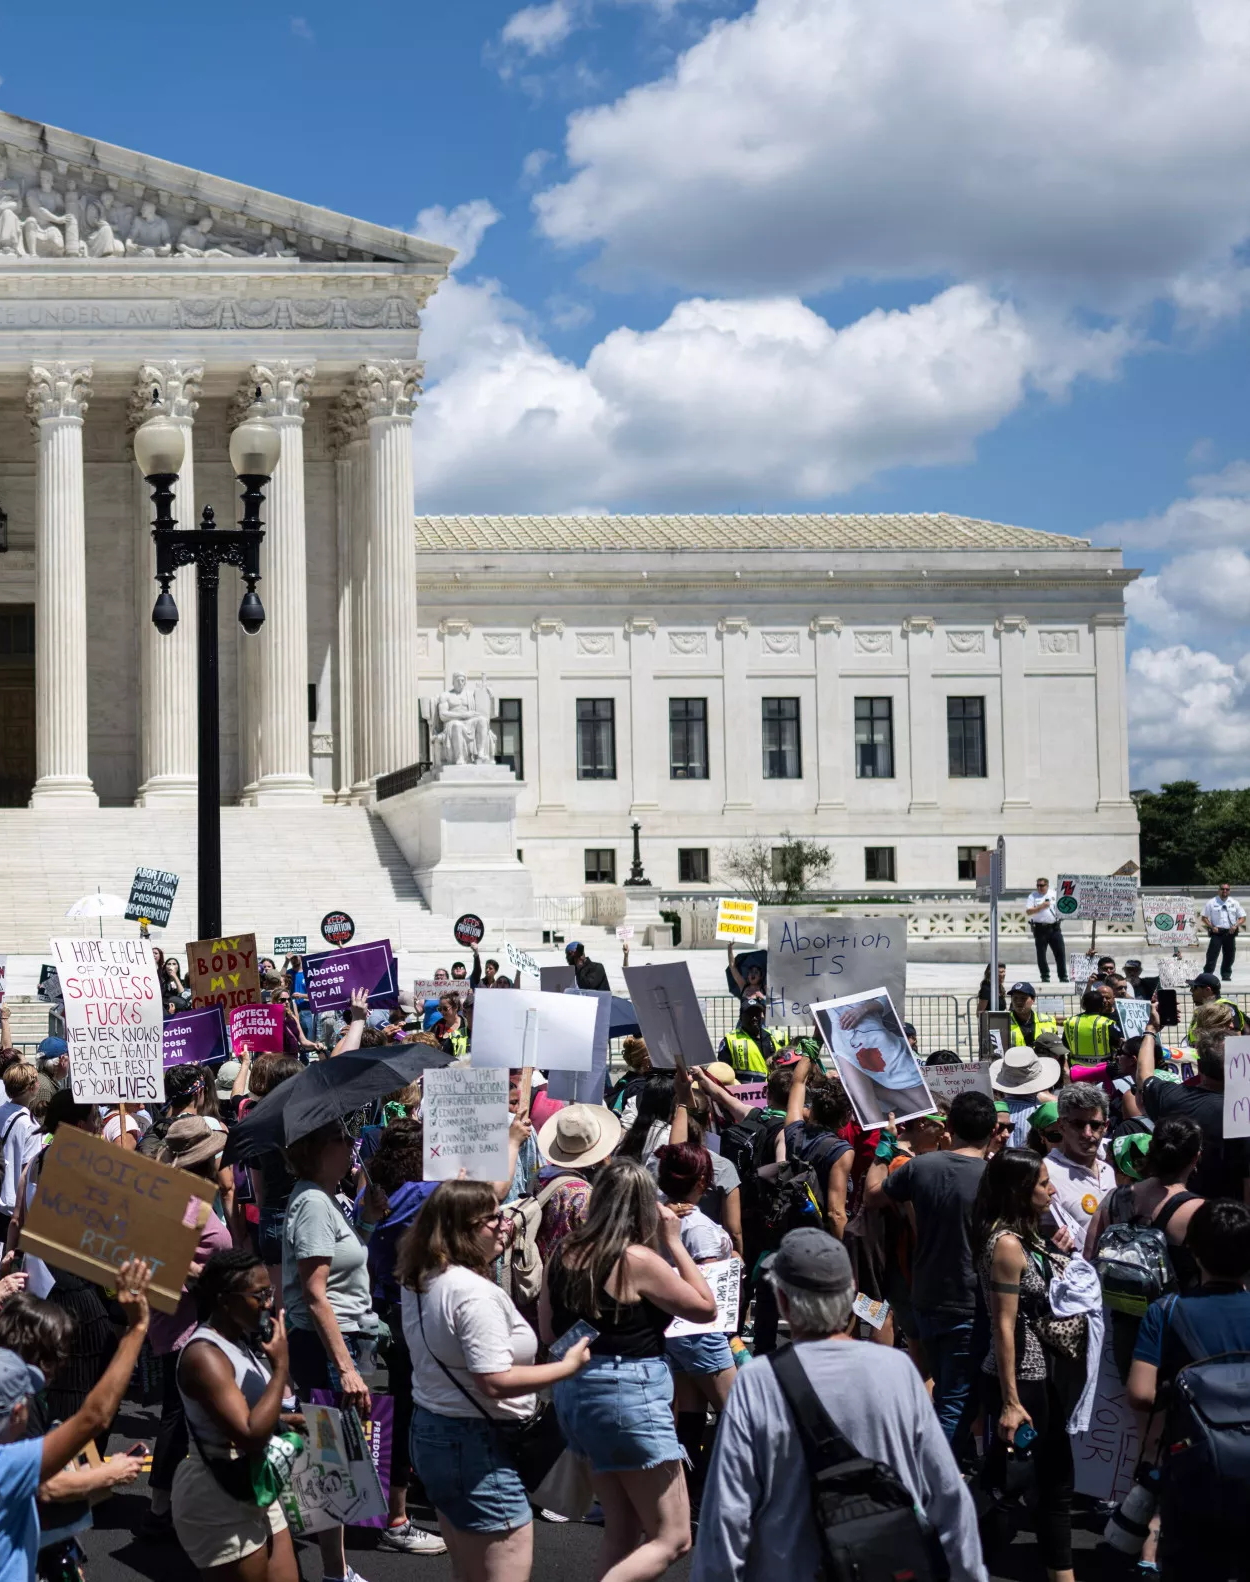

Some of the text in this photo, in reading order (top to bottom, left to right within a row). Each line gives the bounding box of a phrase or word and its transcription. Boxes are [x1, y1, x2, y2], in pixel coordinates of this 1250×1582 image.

[29, 308, 100, 324] UNDER
[113, 308, 157, 324] LAW
[136, 868, 179, 885] ABORTION
[324, 922, 351, 934] ABORTION
[457, 923, 481, 937] ABORTION
[720, 923, 754, 935] PEOPLE
[779, 921, 891, 954] Abortion
[55, 941, 147, 965] I HOPE EACH
[212, 938, 240, 954] MY
[197, 950, 254, 975] BODY
[805, 955, 845, 977] IS
[77, 965, 130, 976] OF YOU
[307, 963, 349, 978] Abortion
[66, 977, 153, 1000] SOULLESS
[211, 973, 240, 991] MY
[309, 975, 345, 988] Access
[311, 986, 341, 999] For All
[416, 990, 436, 998] WITH
[85, 1002, 142, 1026] FUCKS
[233, 1009, 269, 1020] PROTECT
[1130, 1010, 1144, 1019] FUCK
[164, 1026, 192, 1037] ortion
[232, 1018, 277, 1033] SAFE, LEGAL
[67, 1026, 160, 1043] NEVER KNOWS
[233, 1027, 273, 1041] ABORTION
[74, 1045, 116, 1061] PEACE
[120, 1044, 157, 1058] AGAIN
[171, 1049, 183, 1058] All
[73, 1060, 154, 1076] FOR THE REST
[472, 1069, 499, 1081] THAT
[936, 1065, 958, 1075] FAMILY
[73, 1076, 157, 1100] OF YOUR LIVES
[943, 1077, 960, 1085] force
[439, 1107, 475, 1117] EDUCATION
[438, 1117, 478, 1128] COMMUNITY
[442, 1134, 465, 1143] LIVING
[442, 1144, 499, 1156] ABORTION BANS
[56, 1141, 170, 1201] CHOICE
[83, 1185, 129, 1216] IS A
[41, 1187, 129, 1239] WOMEN'S
[717, 1270, 728, 1284] THE
[1082, 1393, 1126, 1463] YOUR
[372, 1421, 381, 1468] FREEDOM
